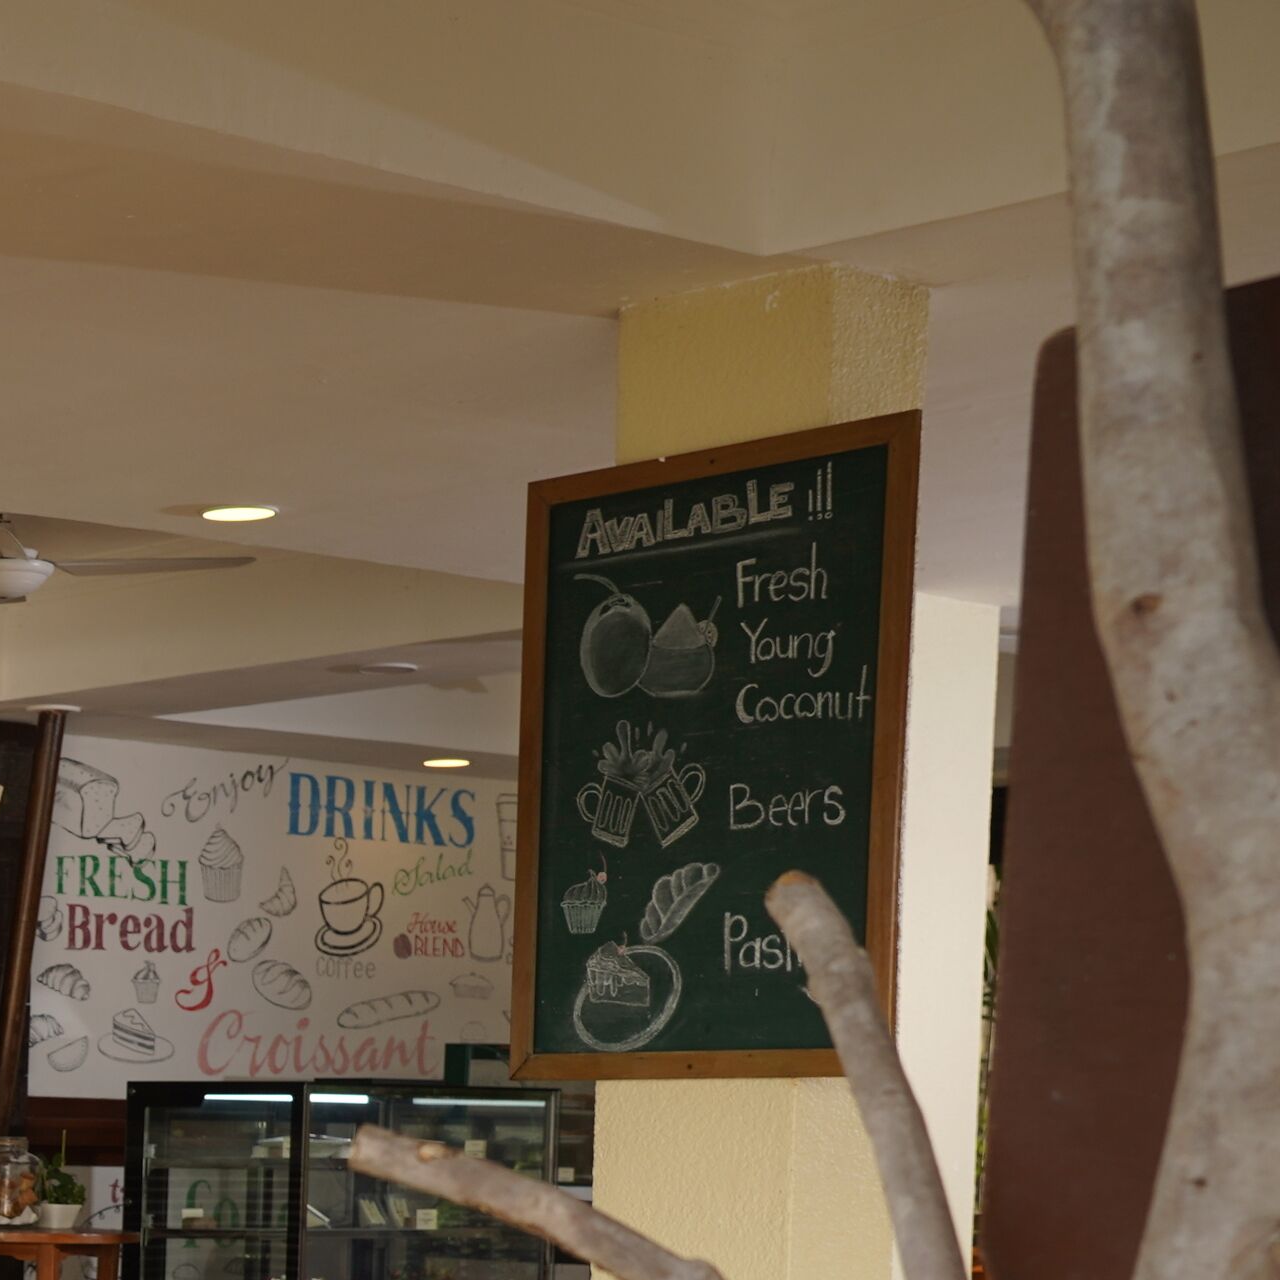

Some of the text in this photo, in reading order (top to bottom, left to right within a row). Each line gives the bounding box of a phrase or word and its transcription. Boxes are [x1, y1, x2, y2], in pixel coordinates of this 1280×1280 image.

[736, 542, 828, 608] Fresh
[741, 617, 837, 678] Young
[736, 664, 872, 724] Coconut
[161, 757, 290, 823] Enjoy
[287, 770, 477, 848] DRINKS
[729, 783, 846, 830] Beers
[54, 854, 190, 907] FRESH
[392, 849, 475, 896] Salad
[65, 903, 197, 954] Bread
[413, 933, 466, 958] BLEND
[197, 1009, 440, 1078] Croissant
